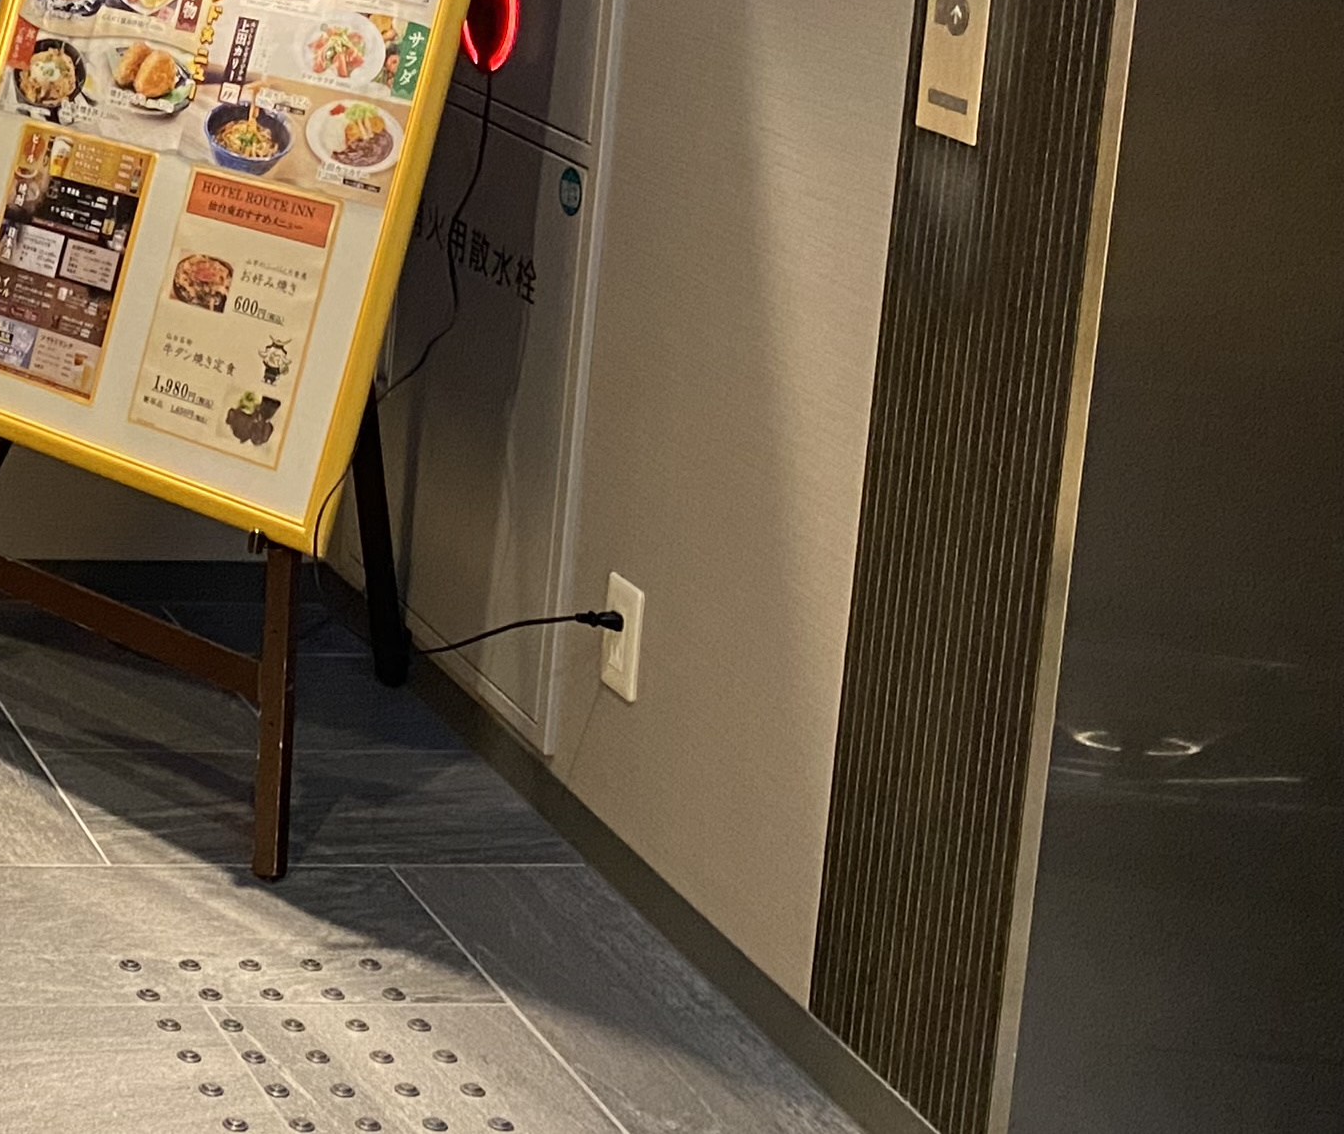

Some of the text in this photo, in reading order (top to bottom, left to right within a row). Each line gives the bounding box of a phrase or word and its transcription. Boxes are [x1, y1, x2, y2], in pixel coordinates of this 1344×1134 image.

[398, 31, 426, 87] サラダ
[201, 180, 317, 218] HOTEL ROUTE INN
